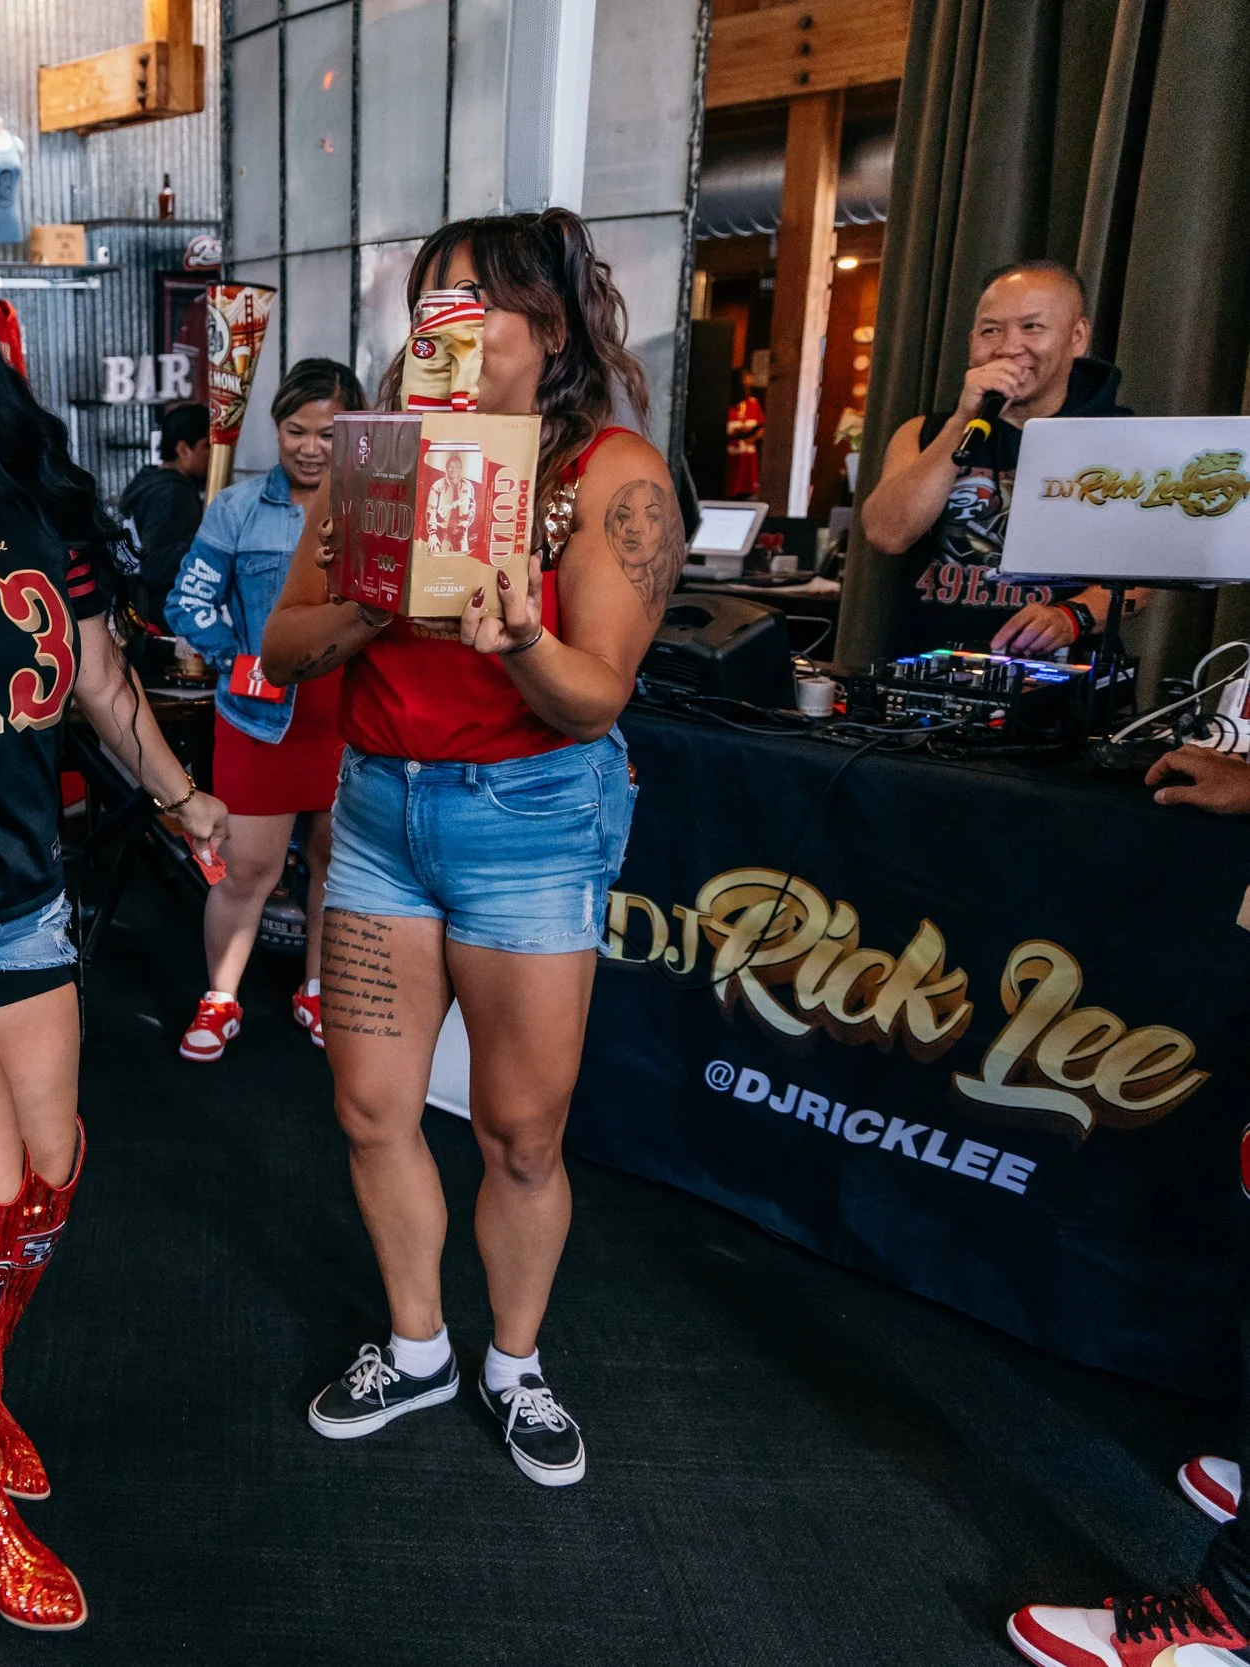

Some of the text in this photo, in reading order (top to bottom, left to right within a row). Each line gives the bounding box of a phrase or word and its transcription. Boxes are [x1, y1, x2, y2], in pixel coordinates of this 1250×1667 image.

[102, 353, 193, 403] BAR
[213, 371, 242, 395] MONK
[1042, 479, 1075, 499] DJ
[1075, 467, 1146, 506] Rick
[361, 499, 413, 541] GOLD
[489, 467, 519, 567] GOLD
[514, 479, 529, 554] DOUBLE
[424, 585, 447, 593] GOLD
[607, 866, 1213, 1135] DJ Rick Lee
[704, 1060, 1037, 1196] @DJRICKLEE
